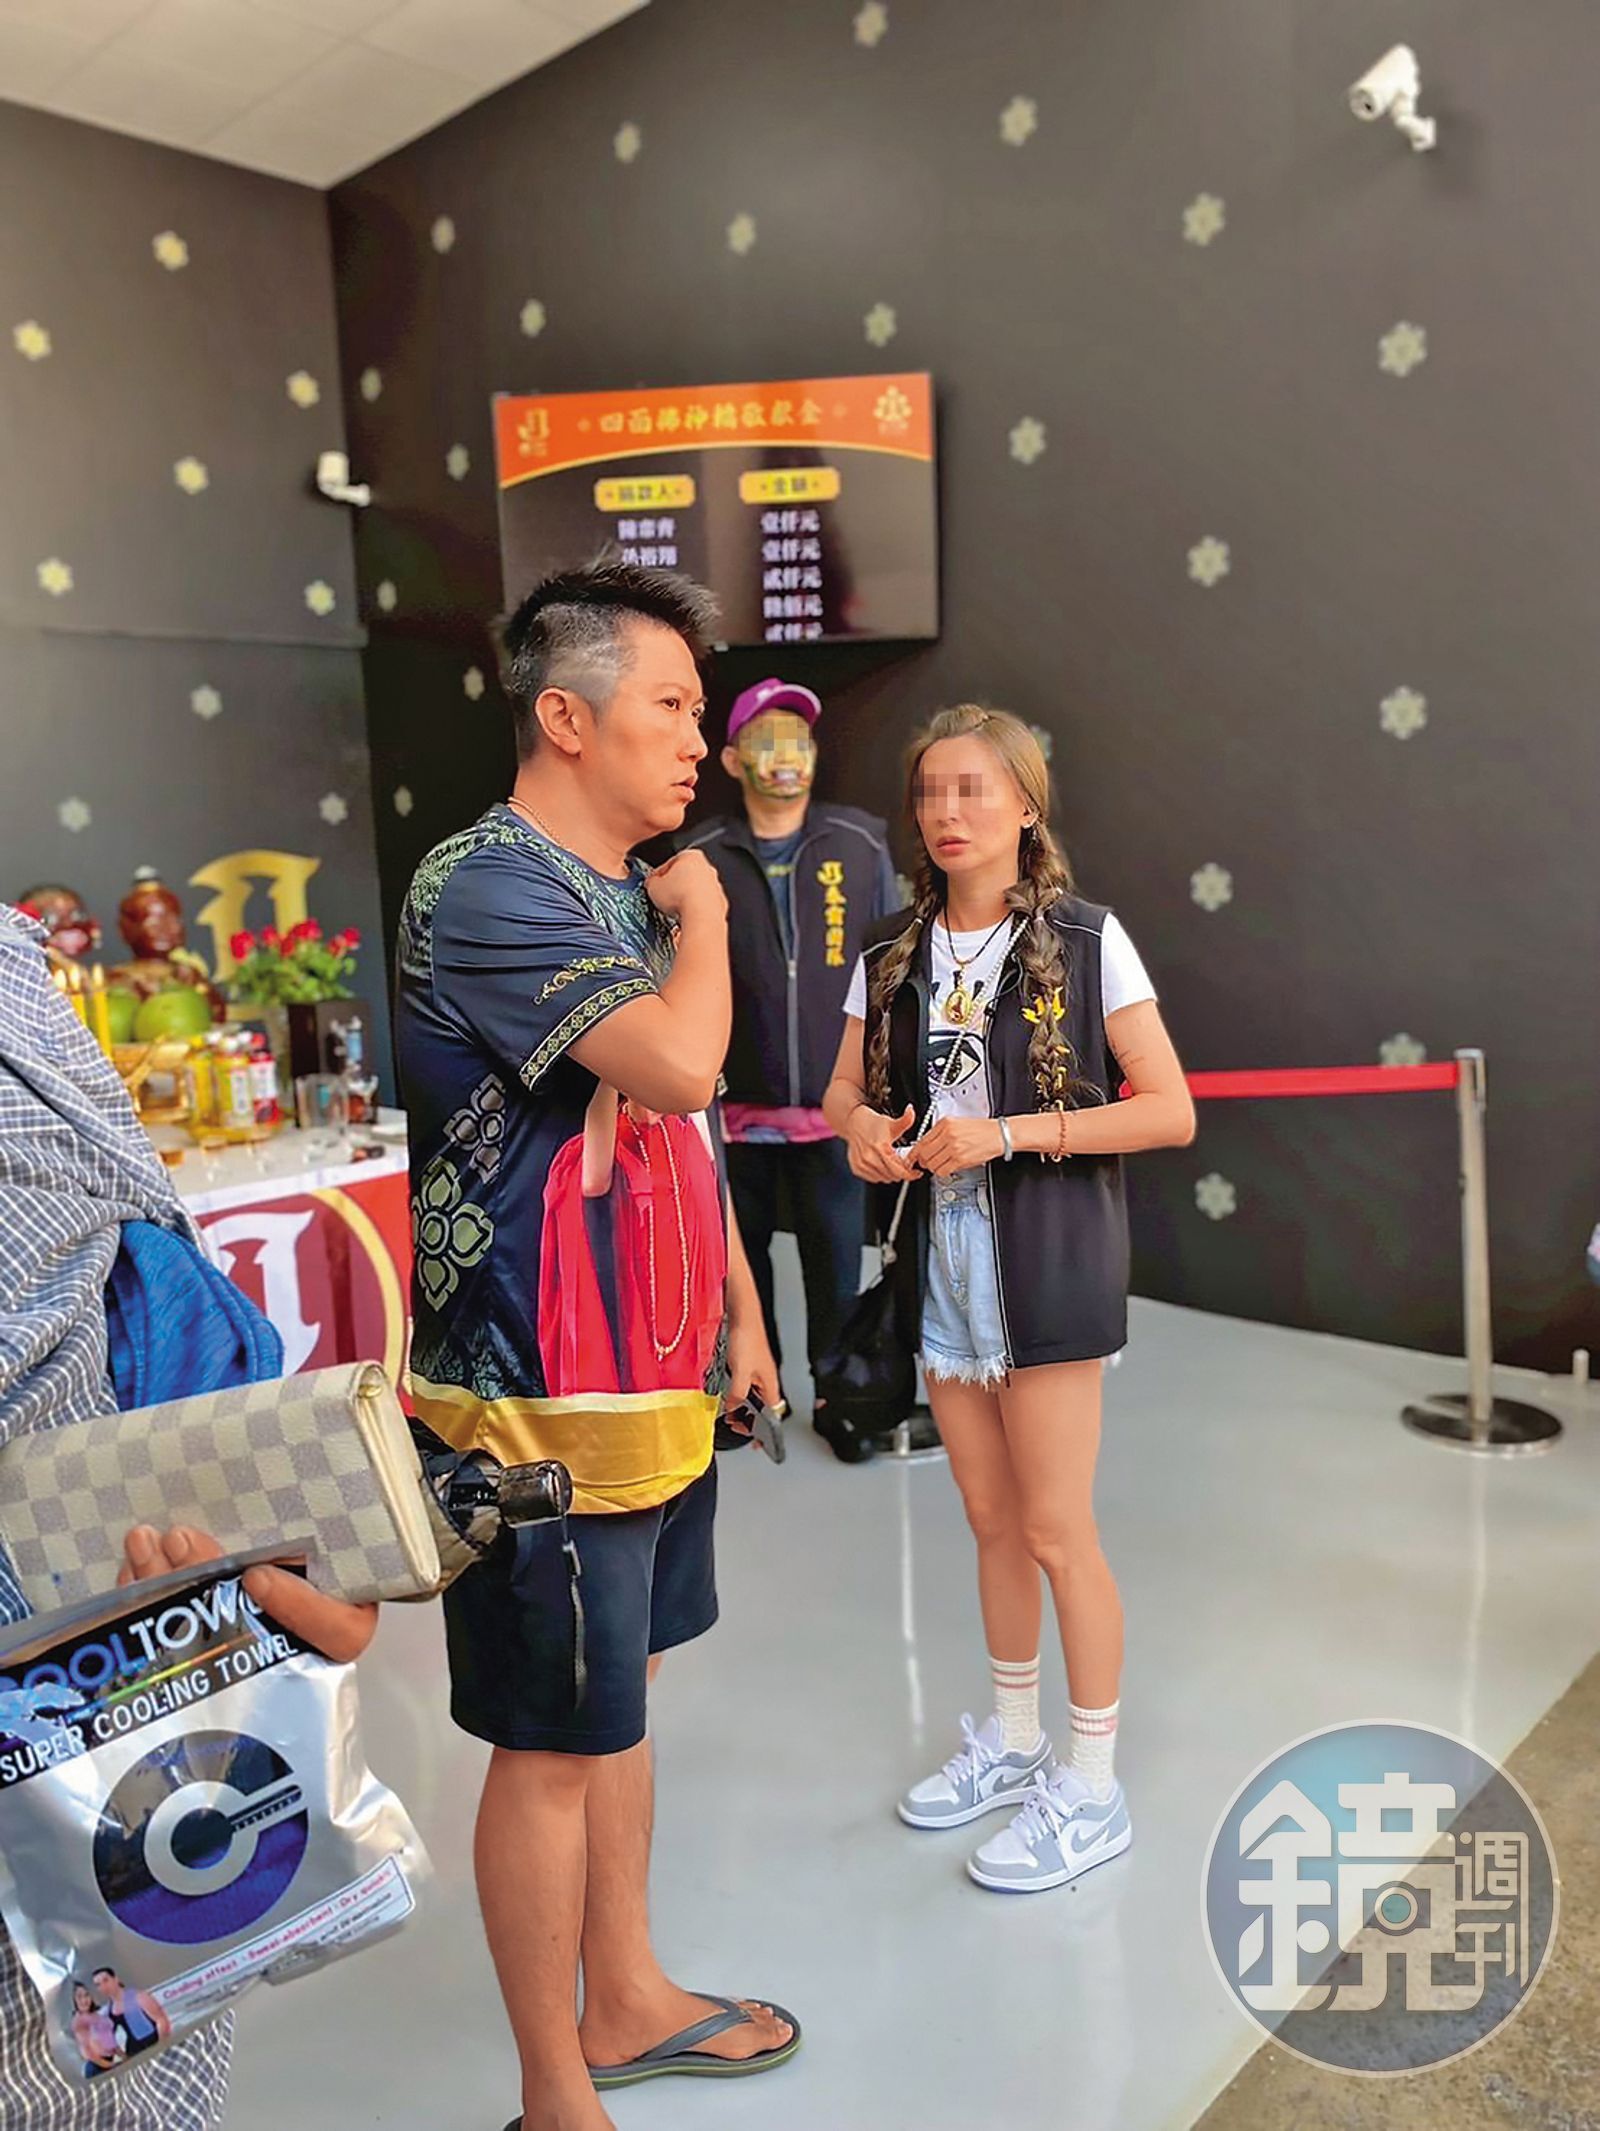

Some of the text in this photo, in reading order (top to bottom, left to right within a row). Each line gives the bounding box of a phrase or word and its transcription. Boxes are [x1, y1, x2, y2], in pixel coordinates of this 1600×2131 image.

[0, 1633, 299, 1782] SUPER COOLING TOWEL
